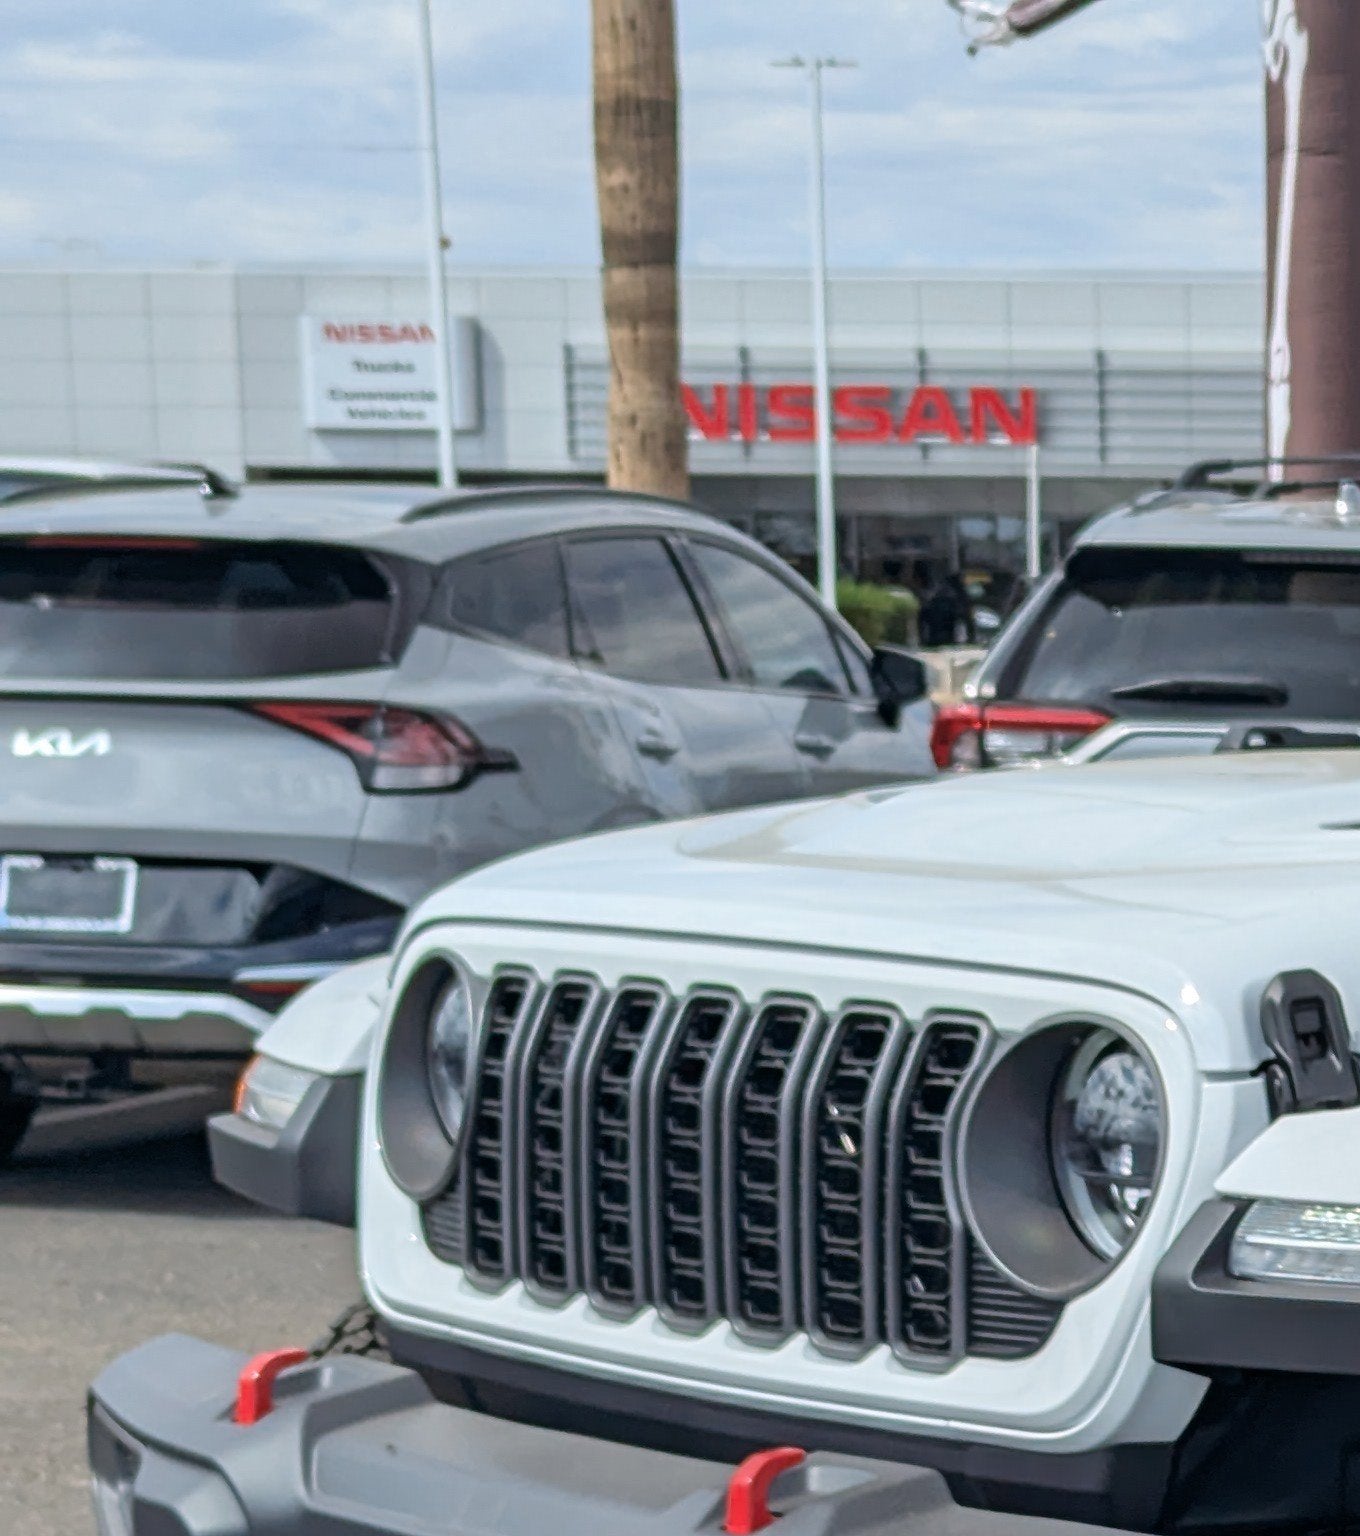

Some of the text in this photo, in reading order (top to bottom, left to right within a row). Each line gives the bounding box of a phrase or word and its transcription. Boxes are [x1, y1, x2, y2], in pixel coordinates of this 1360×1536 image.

[323, 324, 435, 343] NISSAN
[329, 389, 438, 401] Commercia
[680, 383, 1036, 443] NISSAN
[12, 727, 111, 756] KIA
